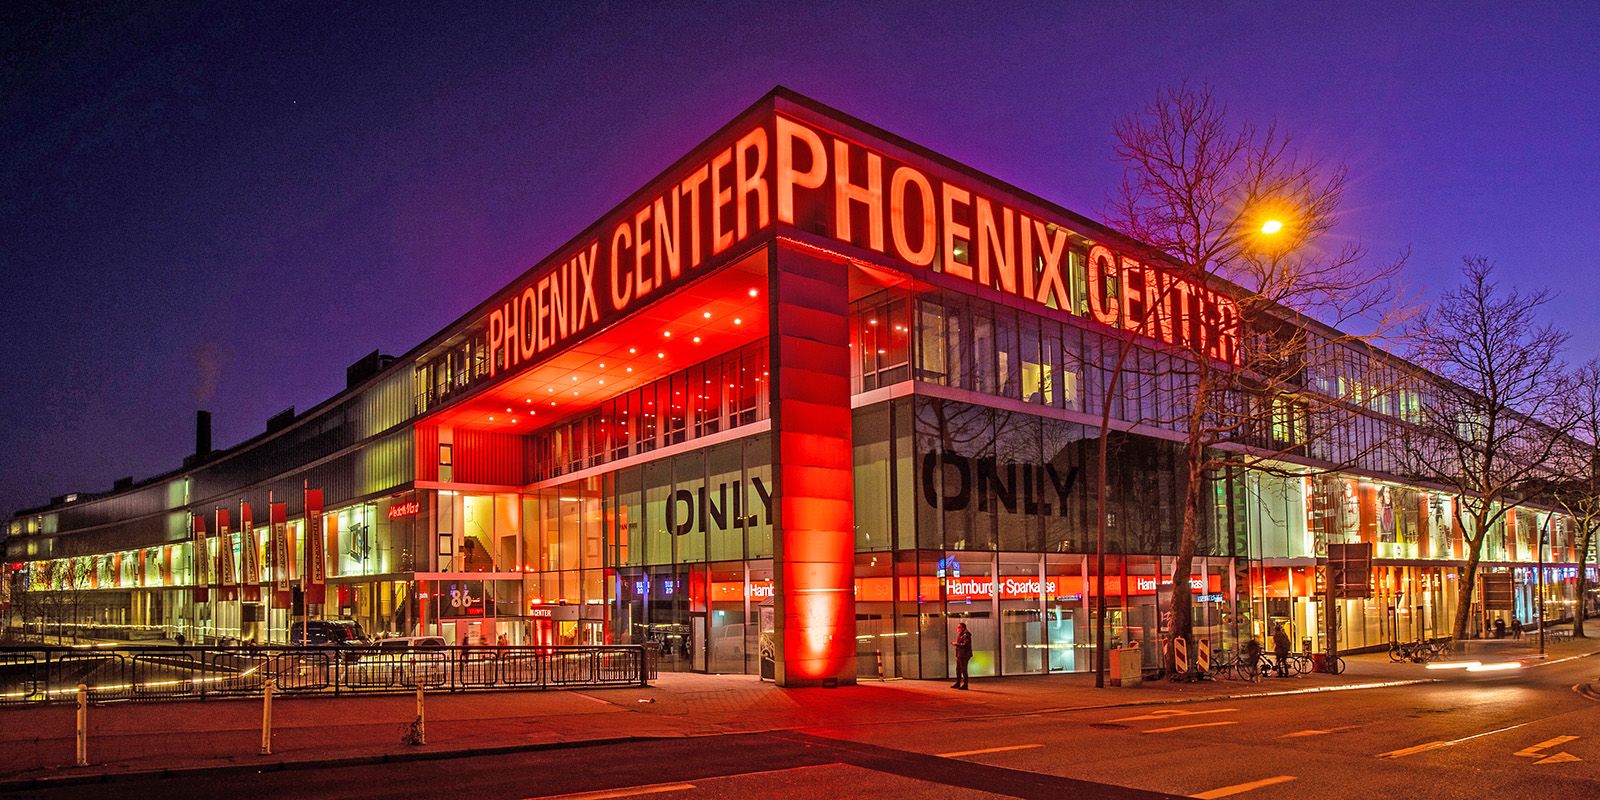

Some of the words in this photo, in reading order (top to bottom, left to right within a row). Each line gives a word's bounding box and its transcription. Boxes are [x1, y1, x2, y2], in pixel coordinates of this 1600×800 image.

[775, 114, 1073, 313] PHOENIX
[488, 238, 600, 378] PHOENIX
[610, 126, 771, 311] CENTER
[665, 477, 773, 536] ONLY
[922, 450, 1079, 517] ONLY
[946, 578, 1005, 597] Hamburgr
[1006, 578, 1056, 597] Sparkase
